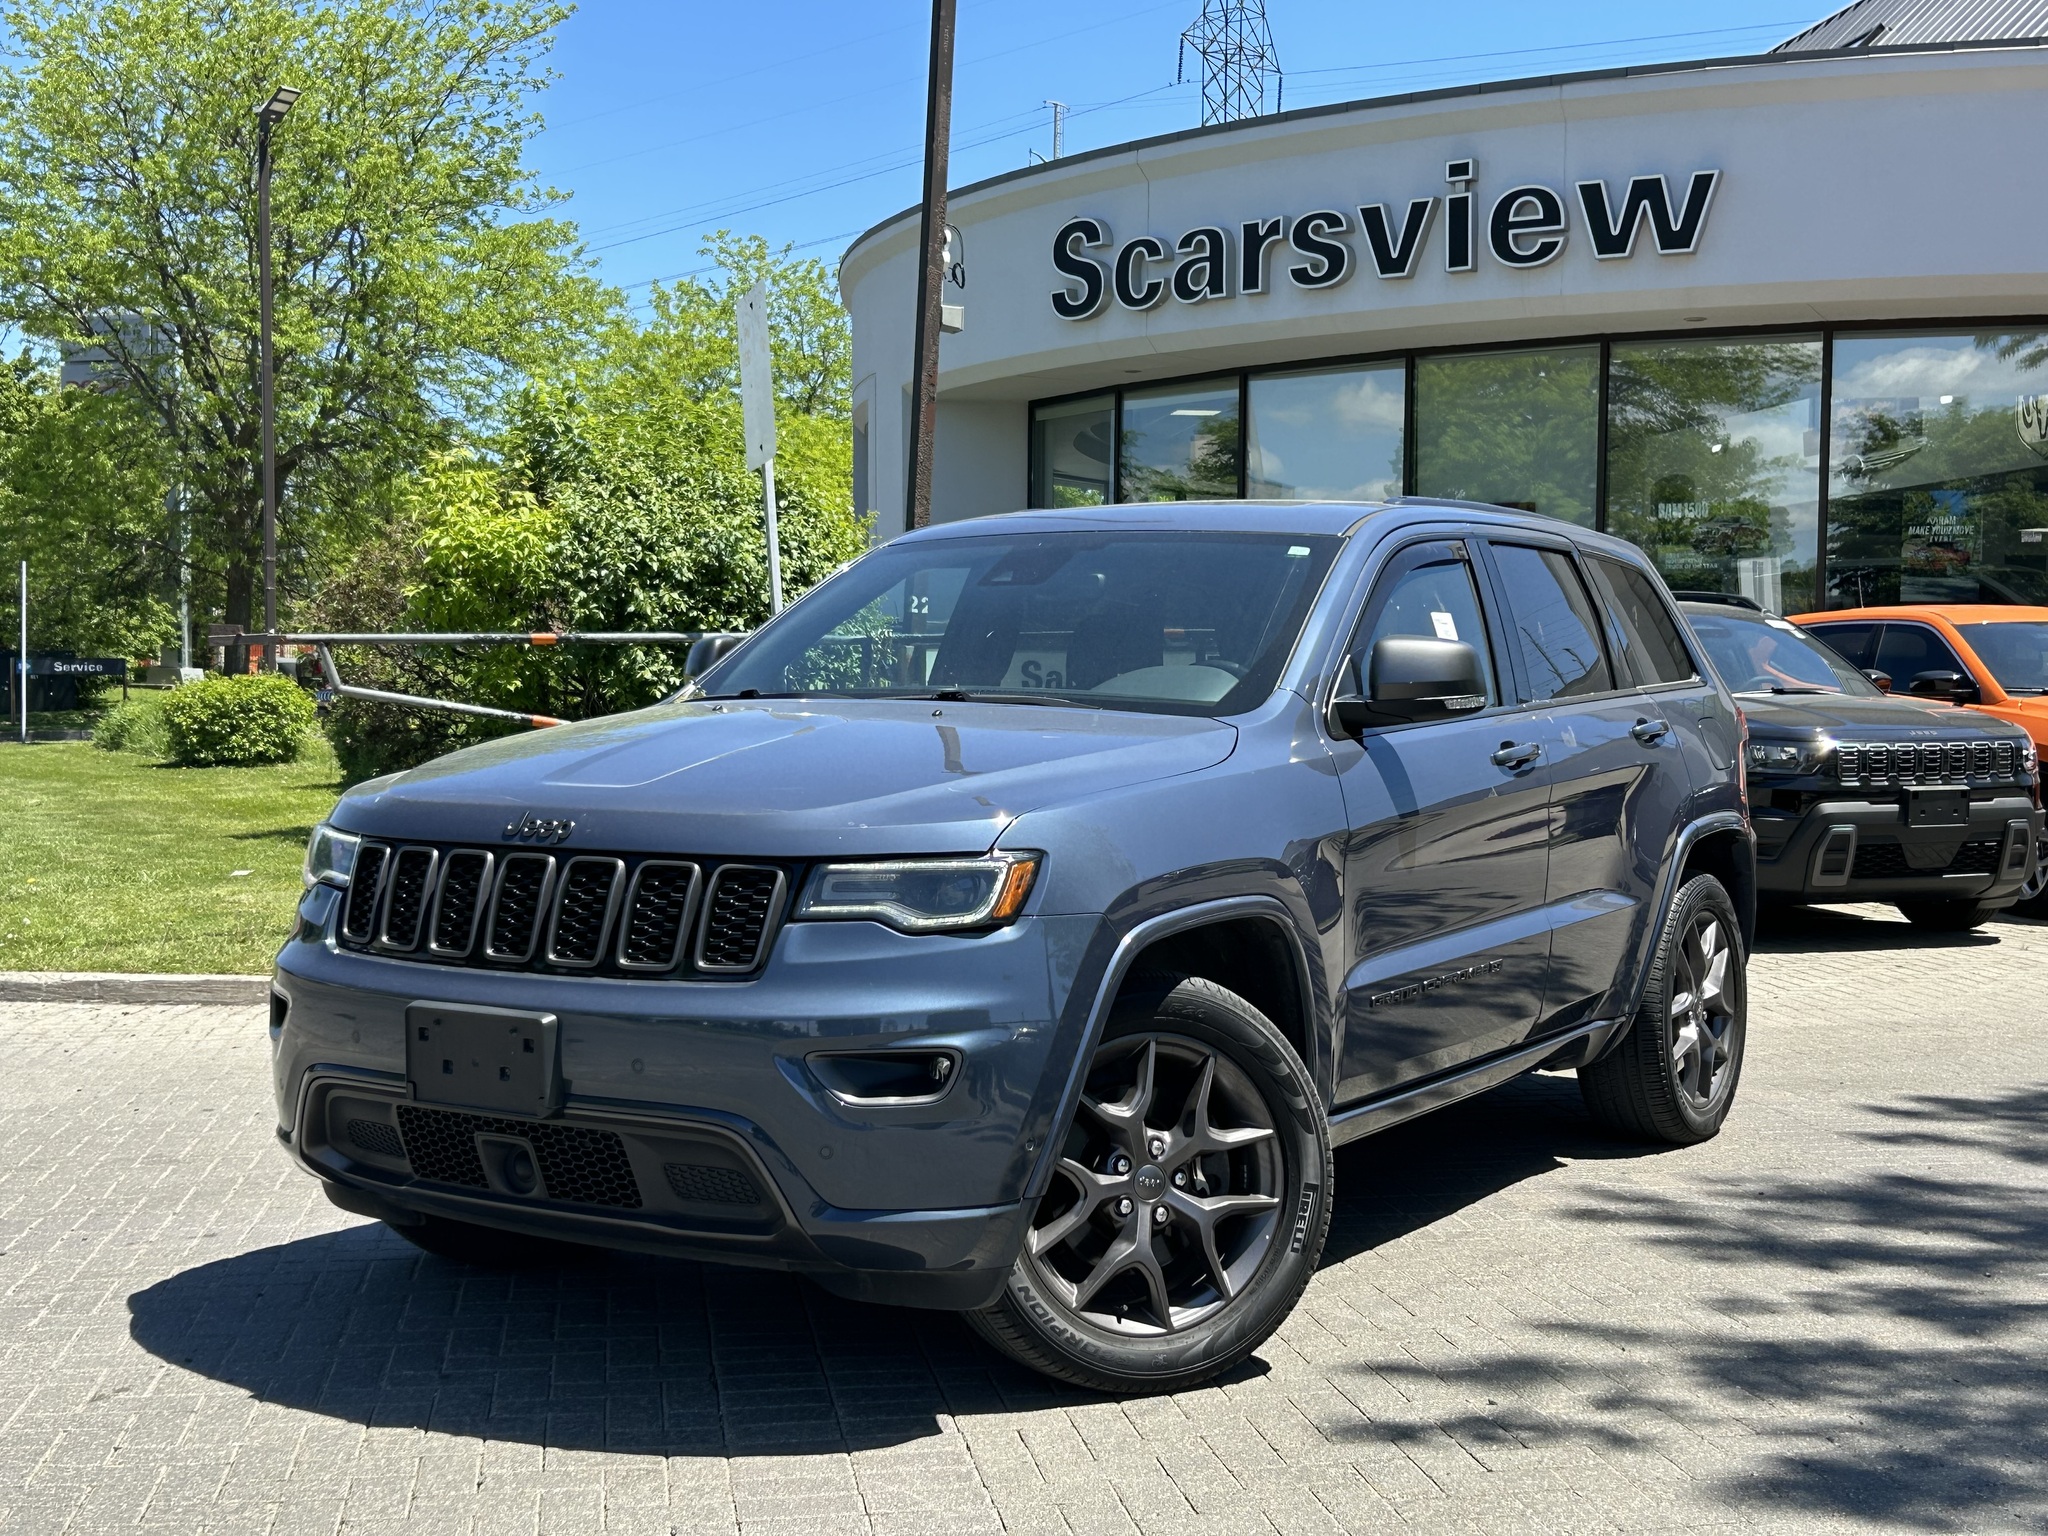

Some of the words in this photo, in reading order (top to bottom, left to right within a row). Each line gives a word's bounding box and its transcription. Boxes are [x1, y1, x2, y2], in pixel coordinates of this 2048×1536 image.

[1049, 158, 1723, 321] Scarsview
[1684, 500, 1709, 518] 1500
[1908, 526, 1930, 535] MAKE
[1931, 526, 1952, 535] YOUR
[1953, 526, 1975, 535] MOVE
[911, 595, 929, 614] 22
[53, 661, 103, 672] Service
[502, 811, 575, 843] Jeep
[1291, 1182, 1319, 1254] PIRELLI
